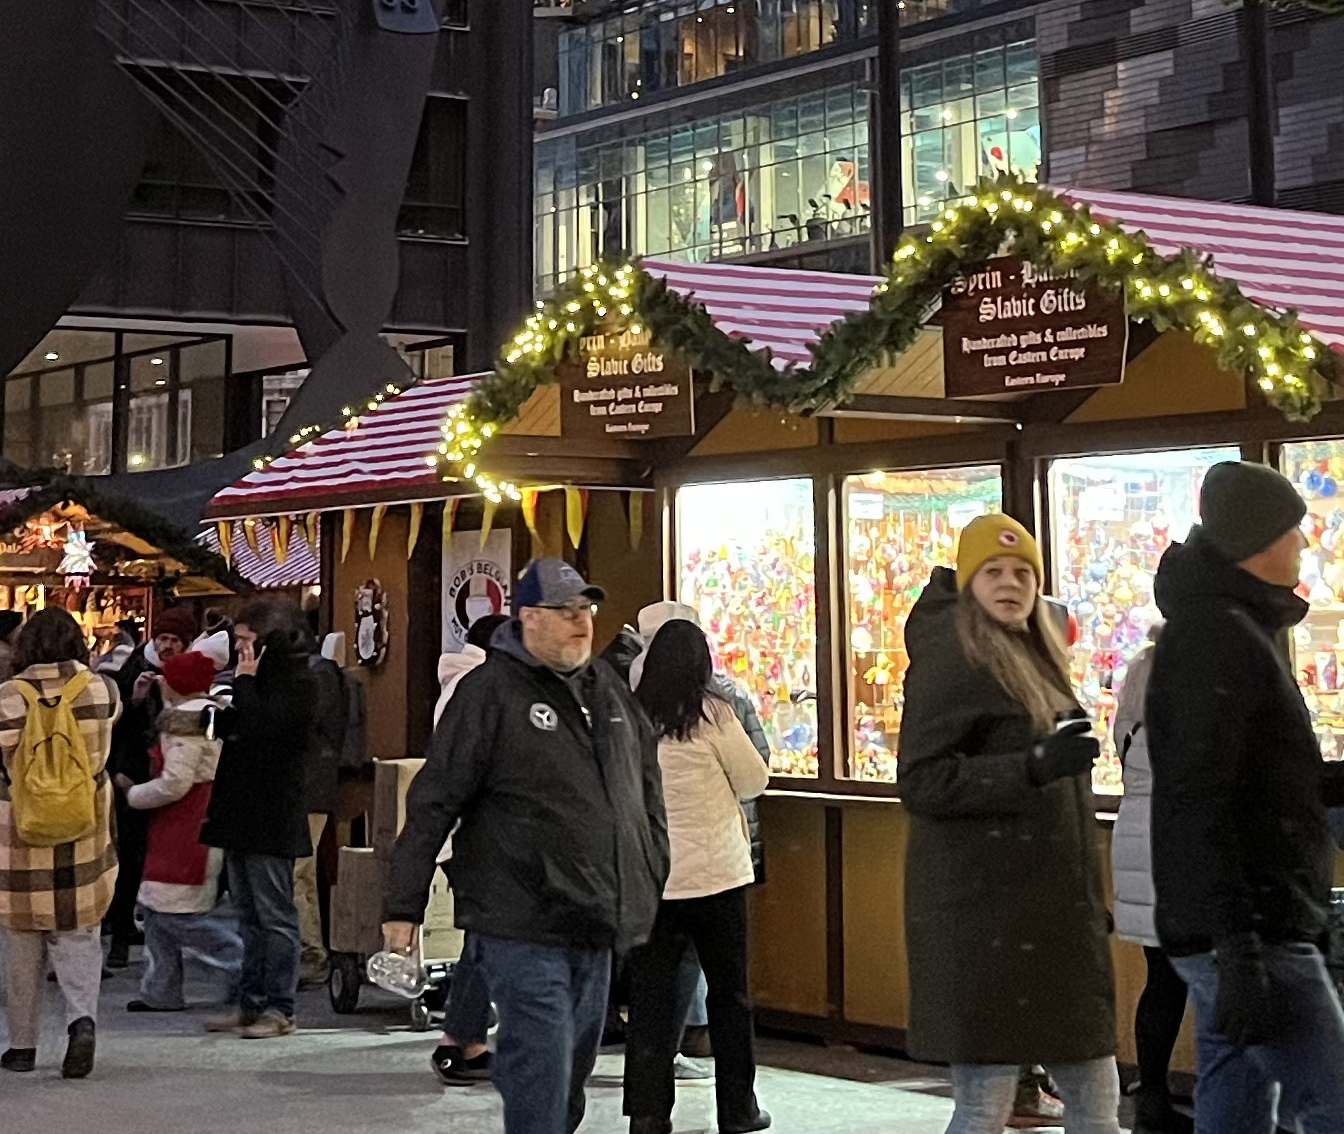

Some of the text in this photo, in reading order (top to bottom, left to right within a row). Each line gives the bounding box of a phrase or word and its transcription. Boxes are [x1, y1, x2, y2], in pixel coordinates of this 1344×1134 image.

[979, 287, 1086, 323] Slavic Gifts
[1044, 328, 1054, 343] &
[586, 351, 664, 378] Slavic Gifts
[984, 346, 1085, 368] from Eastern Europe
